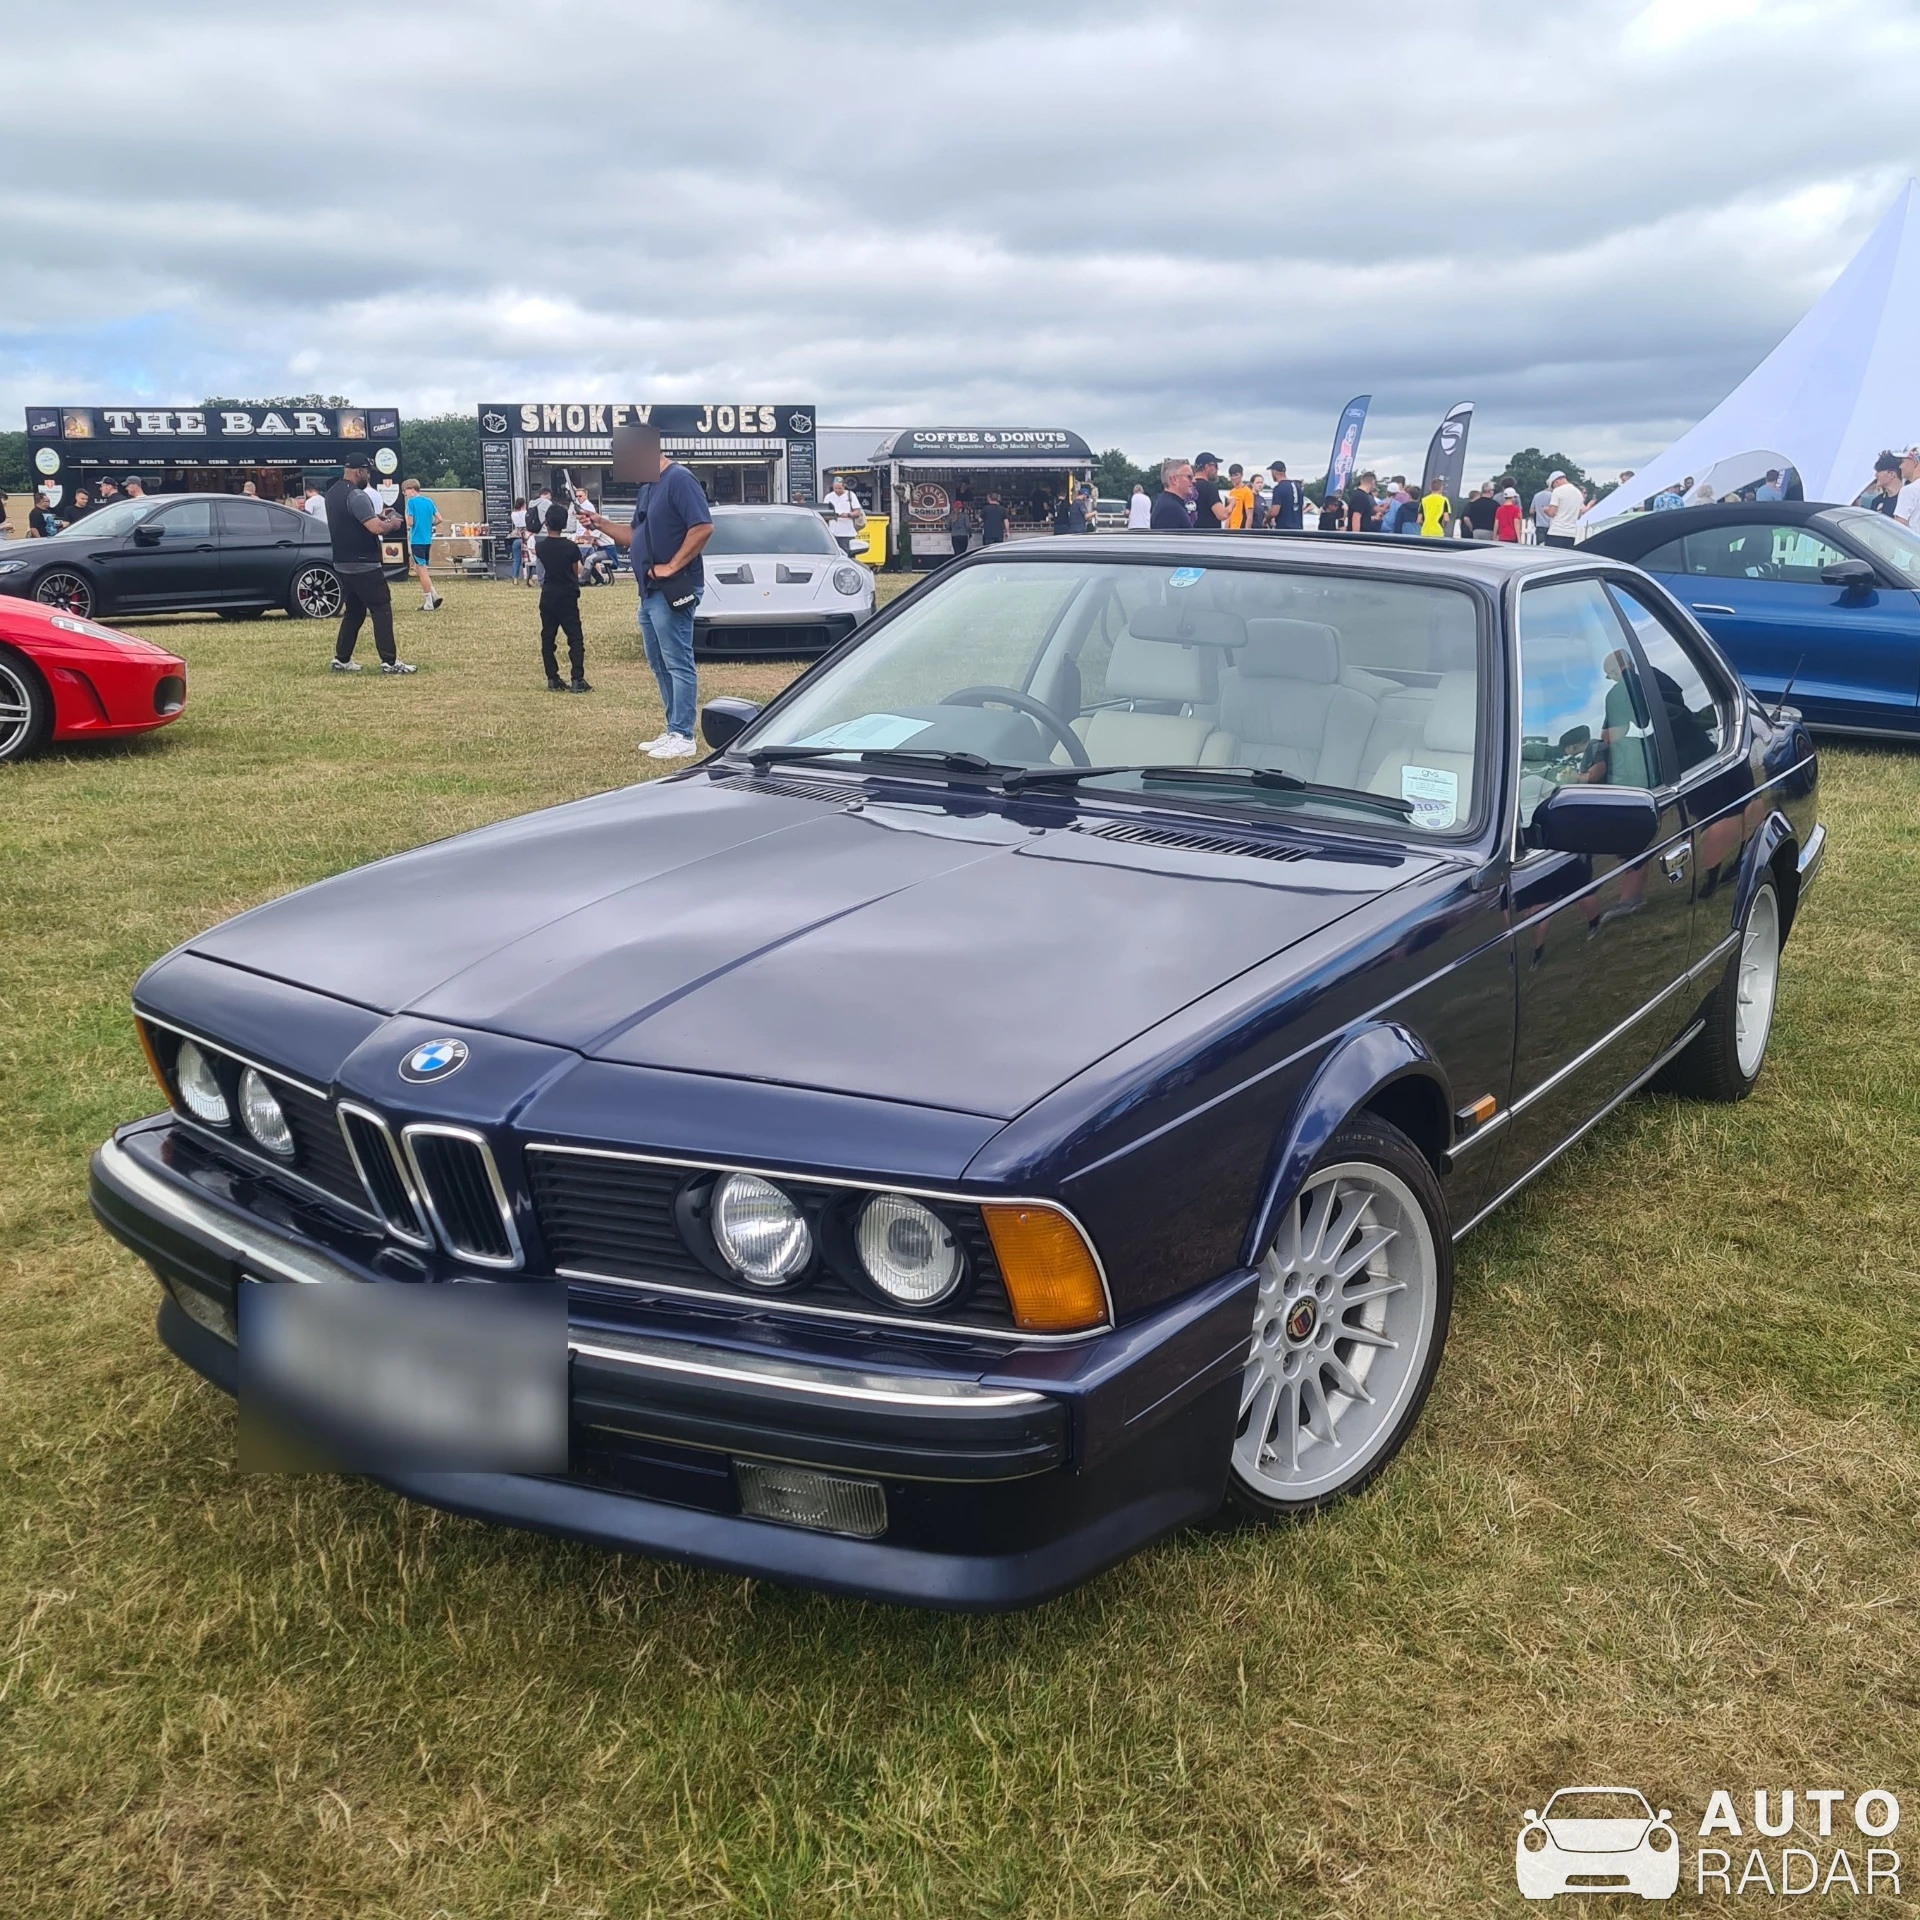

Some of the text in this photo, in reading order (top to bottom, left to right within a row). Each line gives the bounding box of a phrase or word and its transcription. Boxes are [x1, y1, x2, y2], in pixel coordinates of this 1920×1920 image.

[103, 411, 331, 435] THE BAR
[520, 404, 776, 432] SMOKEY JOES
[913, 432, 1066, 442] COFFEE & DONUTS
[672, 594, 695, 607] adidas
